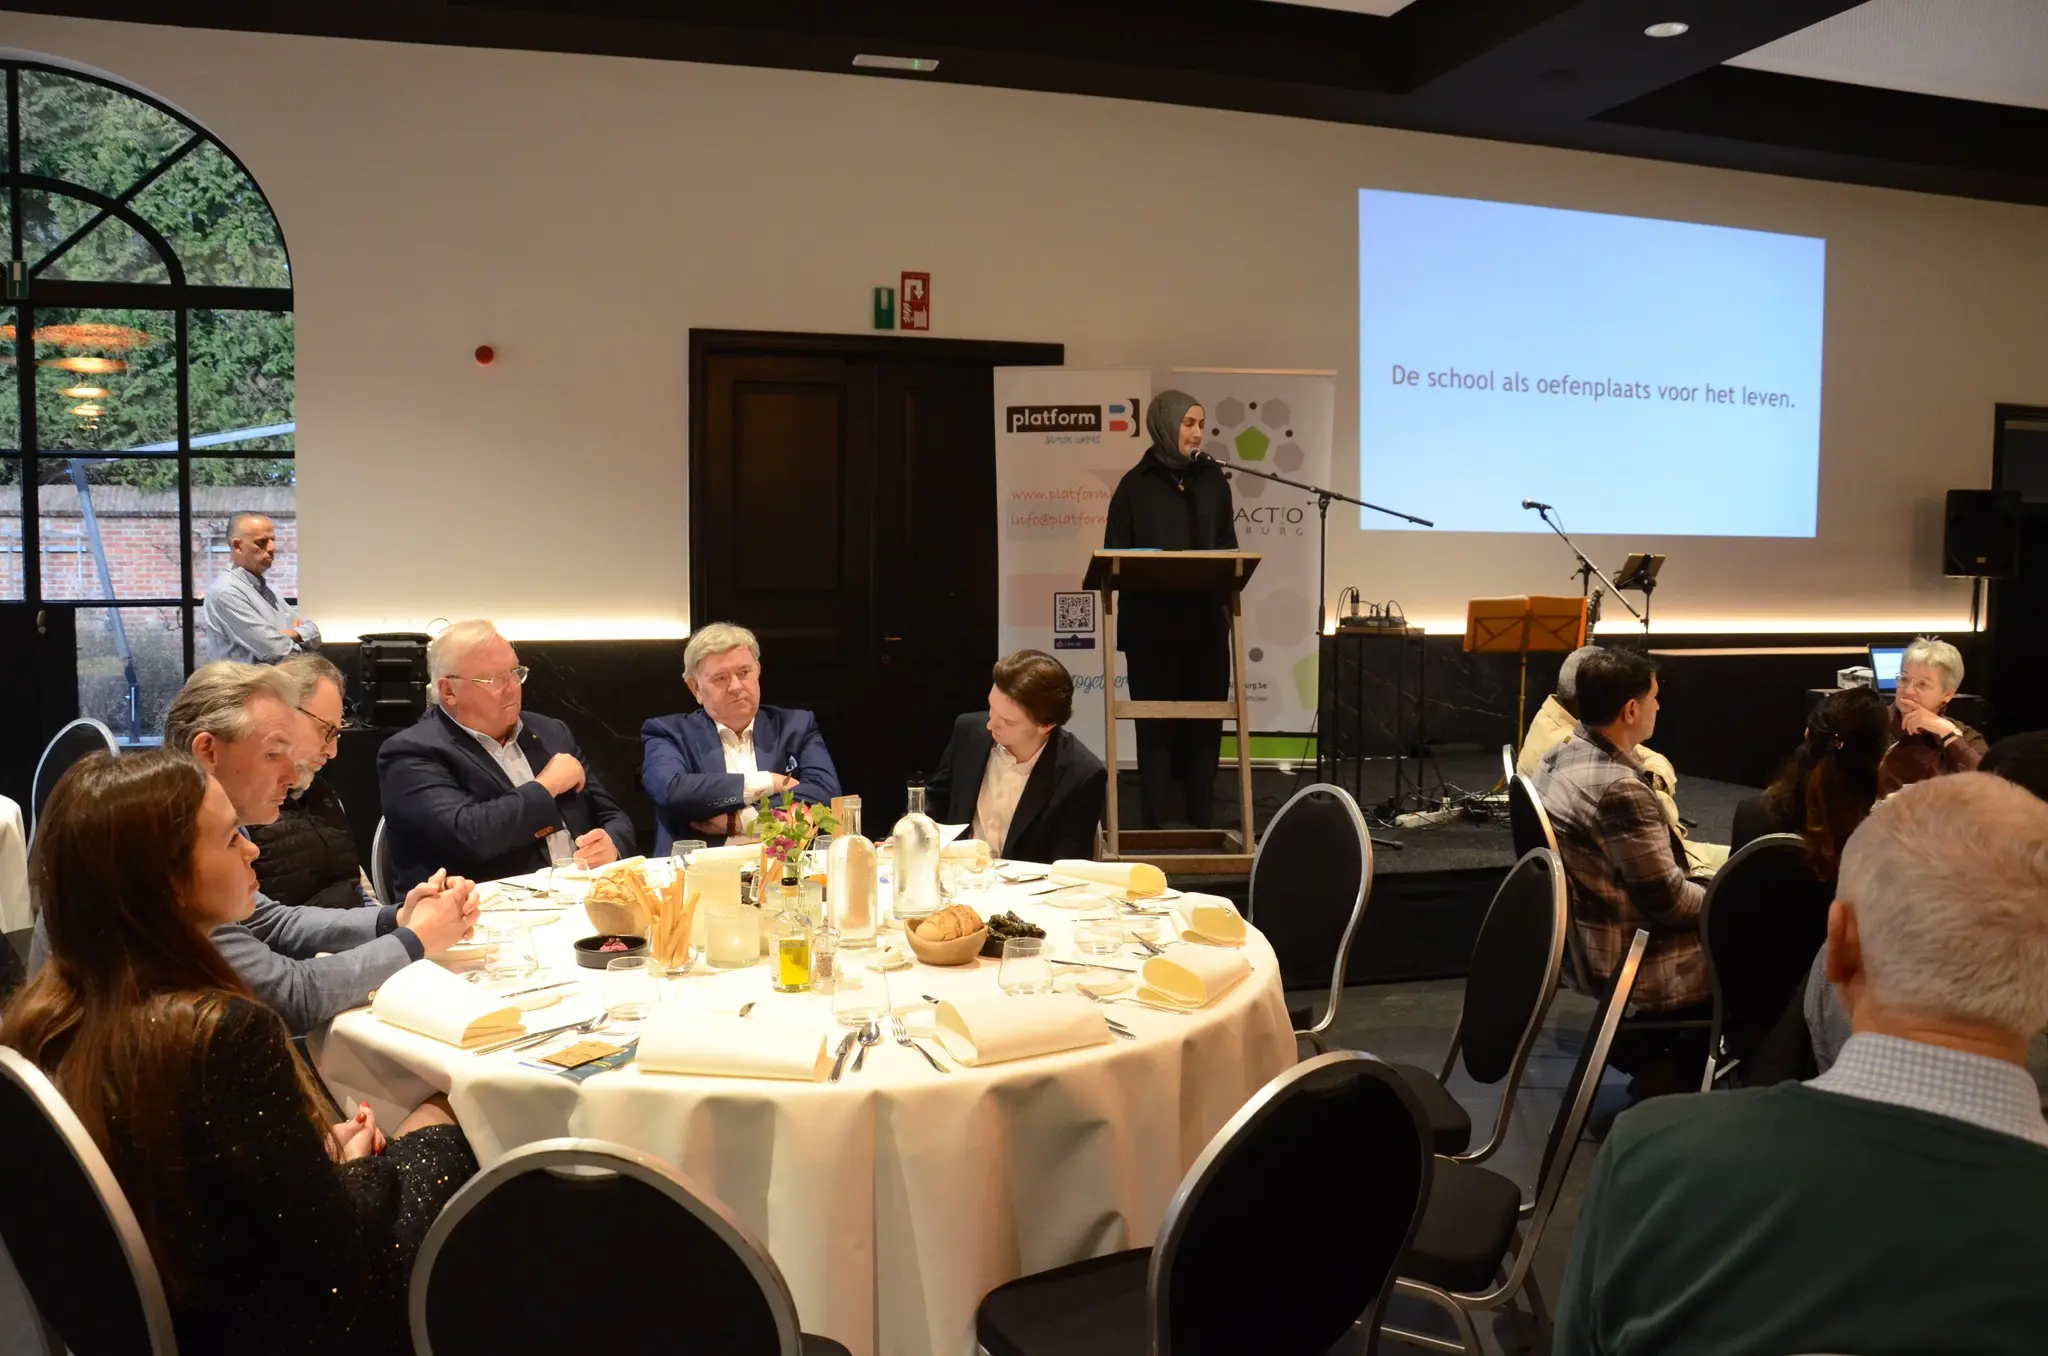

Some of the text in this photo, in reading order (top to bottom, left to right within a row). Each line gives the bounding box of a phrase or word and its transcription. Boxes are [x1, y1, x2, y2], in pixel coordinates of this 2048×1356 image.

[1392, 364, 1796, 409] De school als oefenplaats voor het leven.
[1012, 408, 1096, 433] platform
